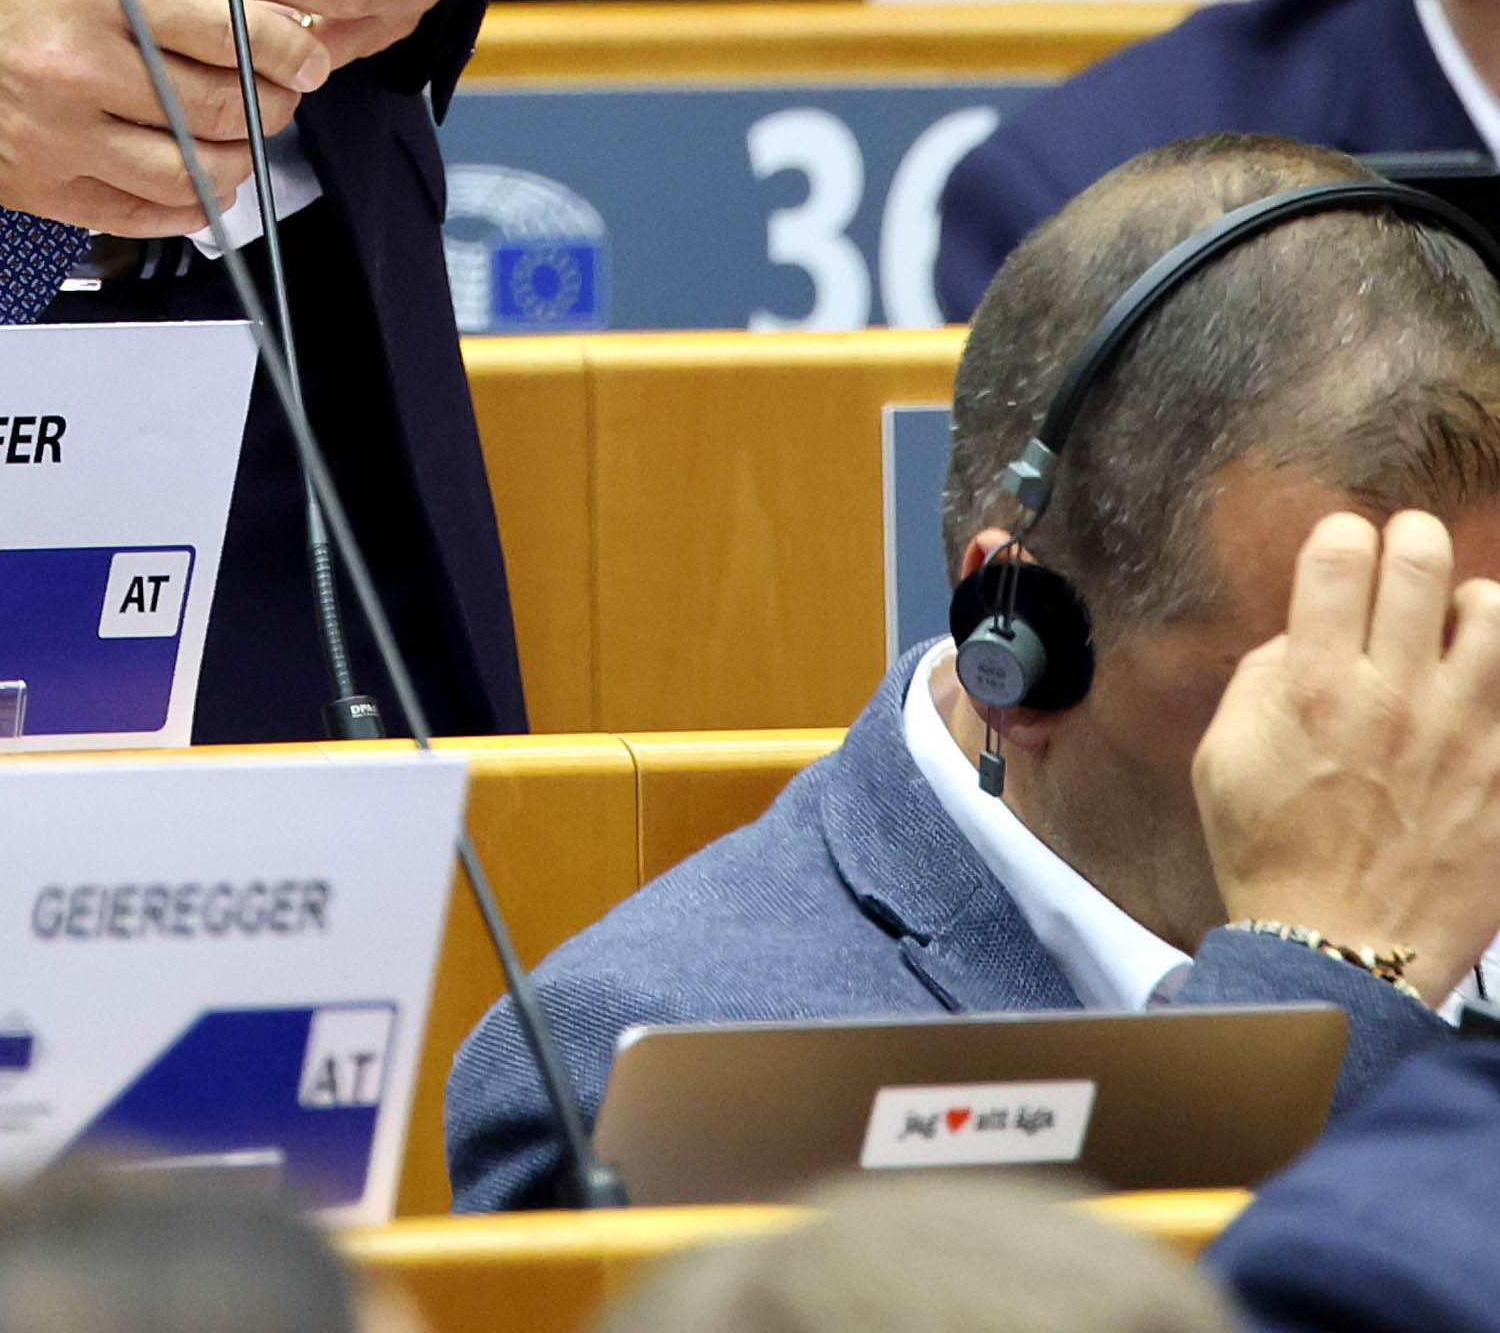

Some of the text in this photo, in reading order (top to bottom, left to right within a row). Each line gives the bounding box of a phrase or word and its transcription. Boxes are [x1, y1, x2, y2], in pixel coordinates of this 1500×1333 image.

[119, 574, 170, 614] AT
[31, 878, 333, 941] GEIEREGGER
[304, 1052, 376, 1105] AT
